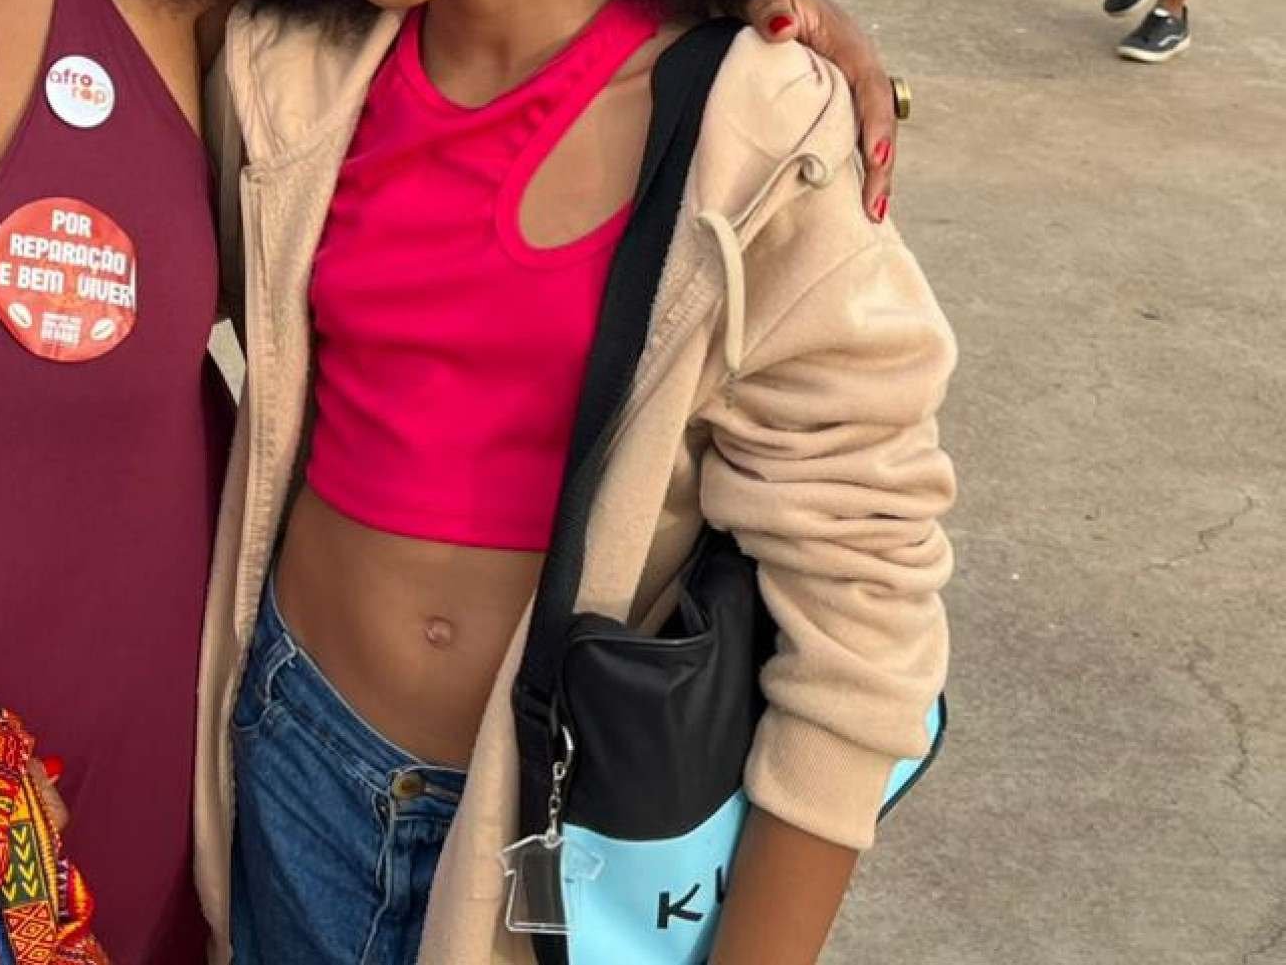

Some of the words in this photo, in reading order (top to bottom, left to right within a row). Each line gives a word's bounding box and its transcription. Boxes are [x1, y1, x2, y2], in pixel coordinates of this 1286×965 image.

[49, 67, 94, 88] afro
[51, 209, 93, 237] POR
[10, 233, 127, 275] REPARAÇÃO
[17, 264, 65, 294] BEM
[77, 271, 134, 308] VIVER
